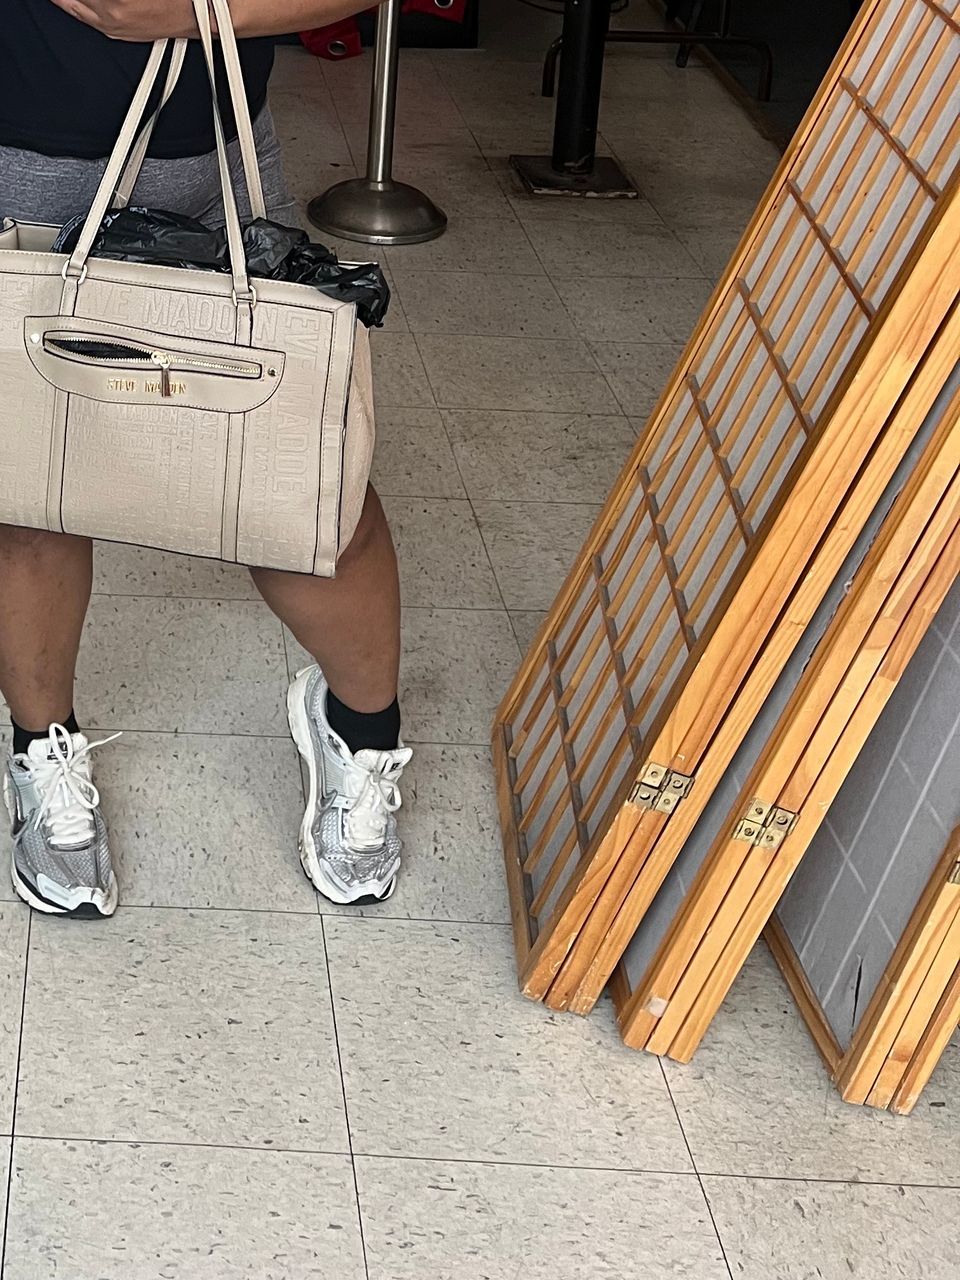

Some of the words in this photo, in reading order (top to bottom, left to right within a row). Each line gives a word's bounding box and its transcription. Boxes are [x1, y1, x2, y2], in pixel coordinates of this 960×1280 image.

[144, 290, 278, 345] MADDN
[106, 378, 138, 393] STEVE
[144, 380, 187, 395] MADEN
